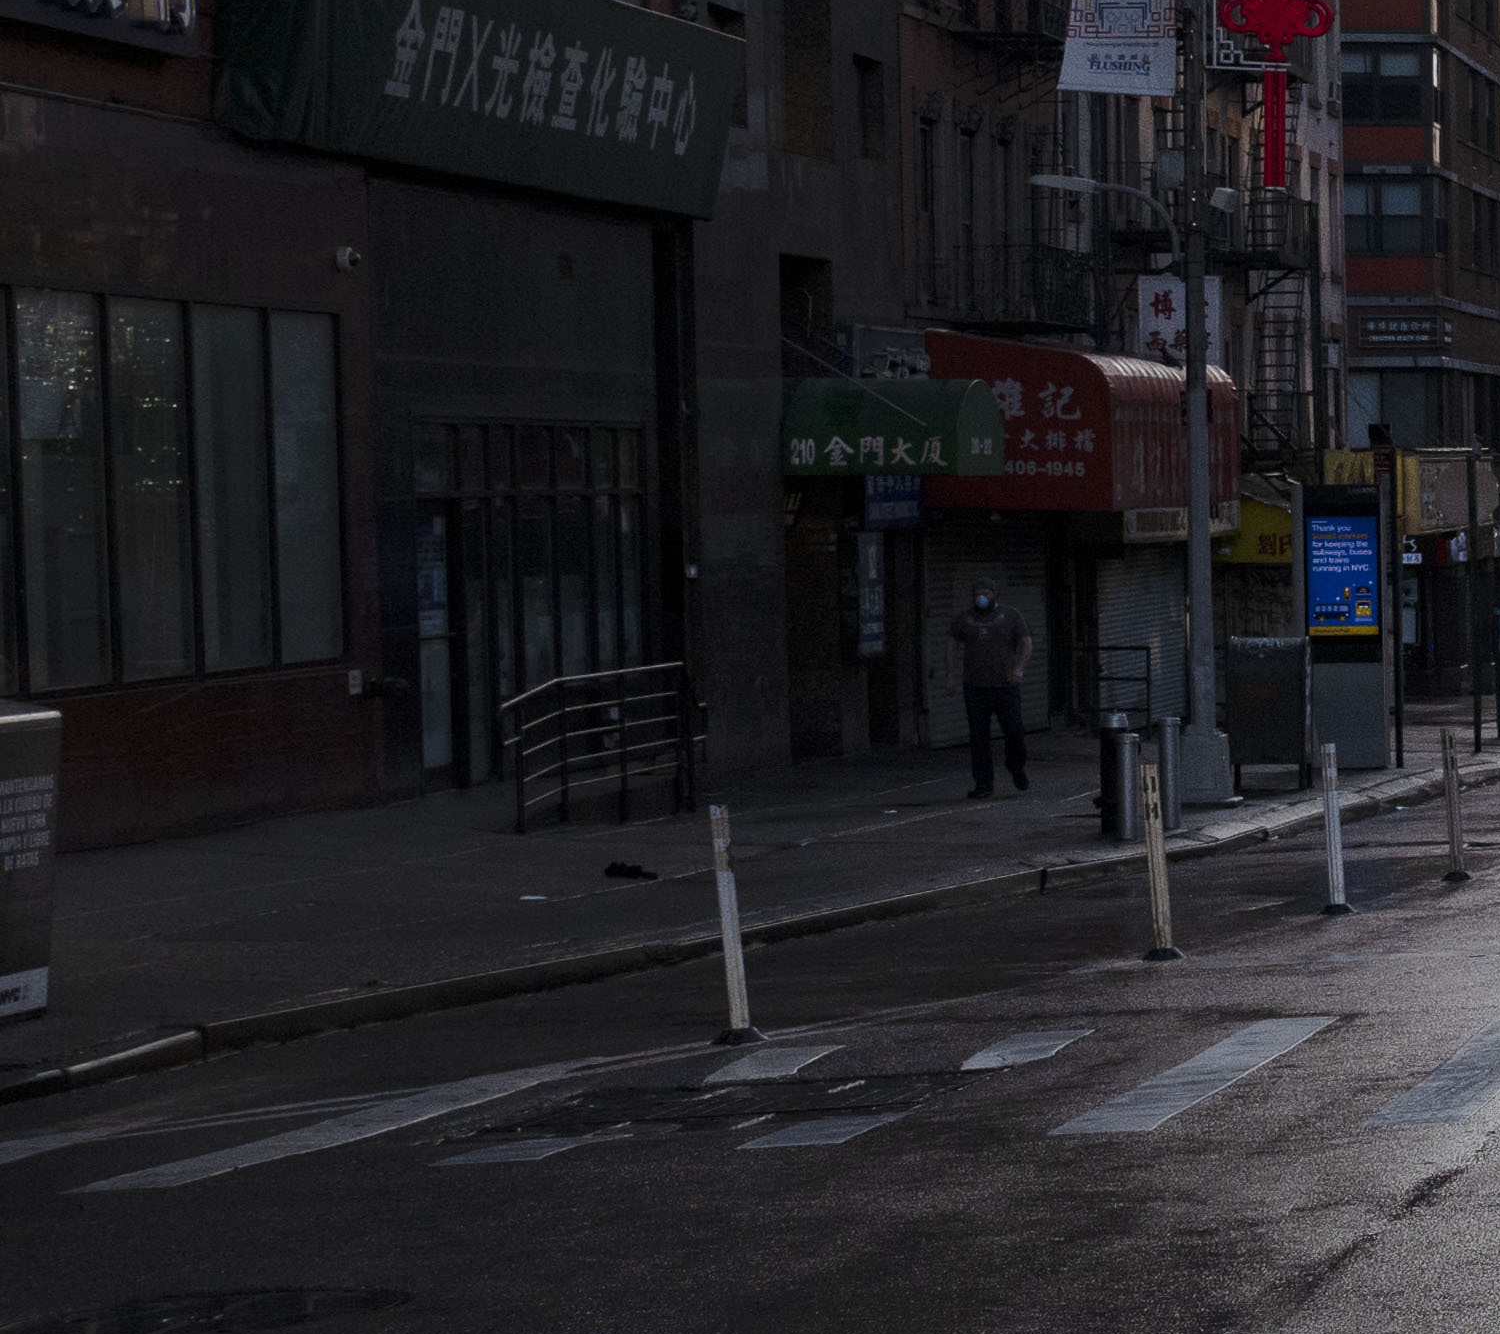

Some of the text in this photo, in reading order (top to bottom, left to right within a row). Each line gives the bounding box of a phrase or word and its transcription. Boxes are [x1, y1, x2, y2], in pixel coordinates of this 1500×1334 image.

[1088, 61, 1150, 72] FLUSHING
[1004, 428, 1097, 454] 大排檔
[790, 438, 816, 466] 210
[1312, 524, 1351, 534] Thank you
[1312, 540, 1369, 550] for keeping the
[1312, 548, 1373, 558] subways, buses
[1312, 564, 1370, 574] running in NYC.
